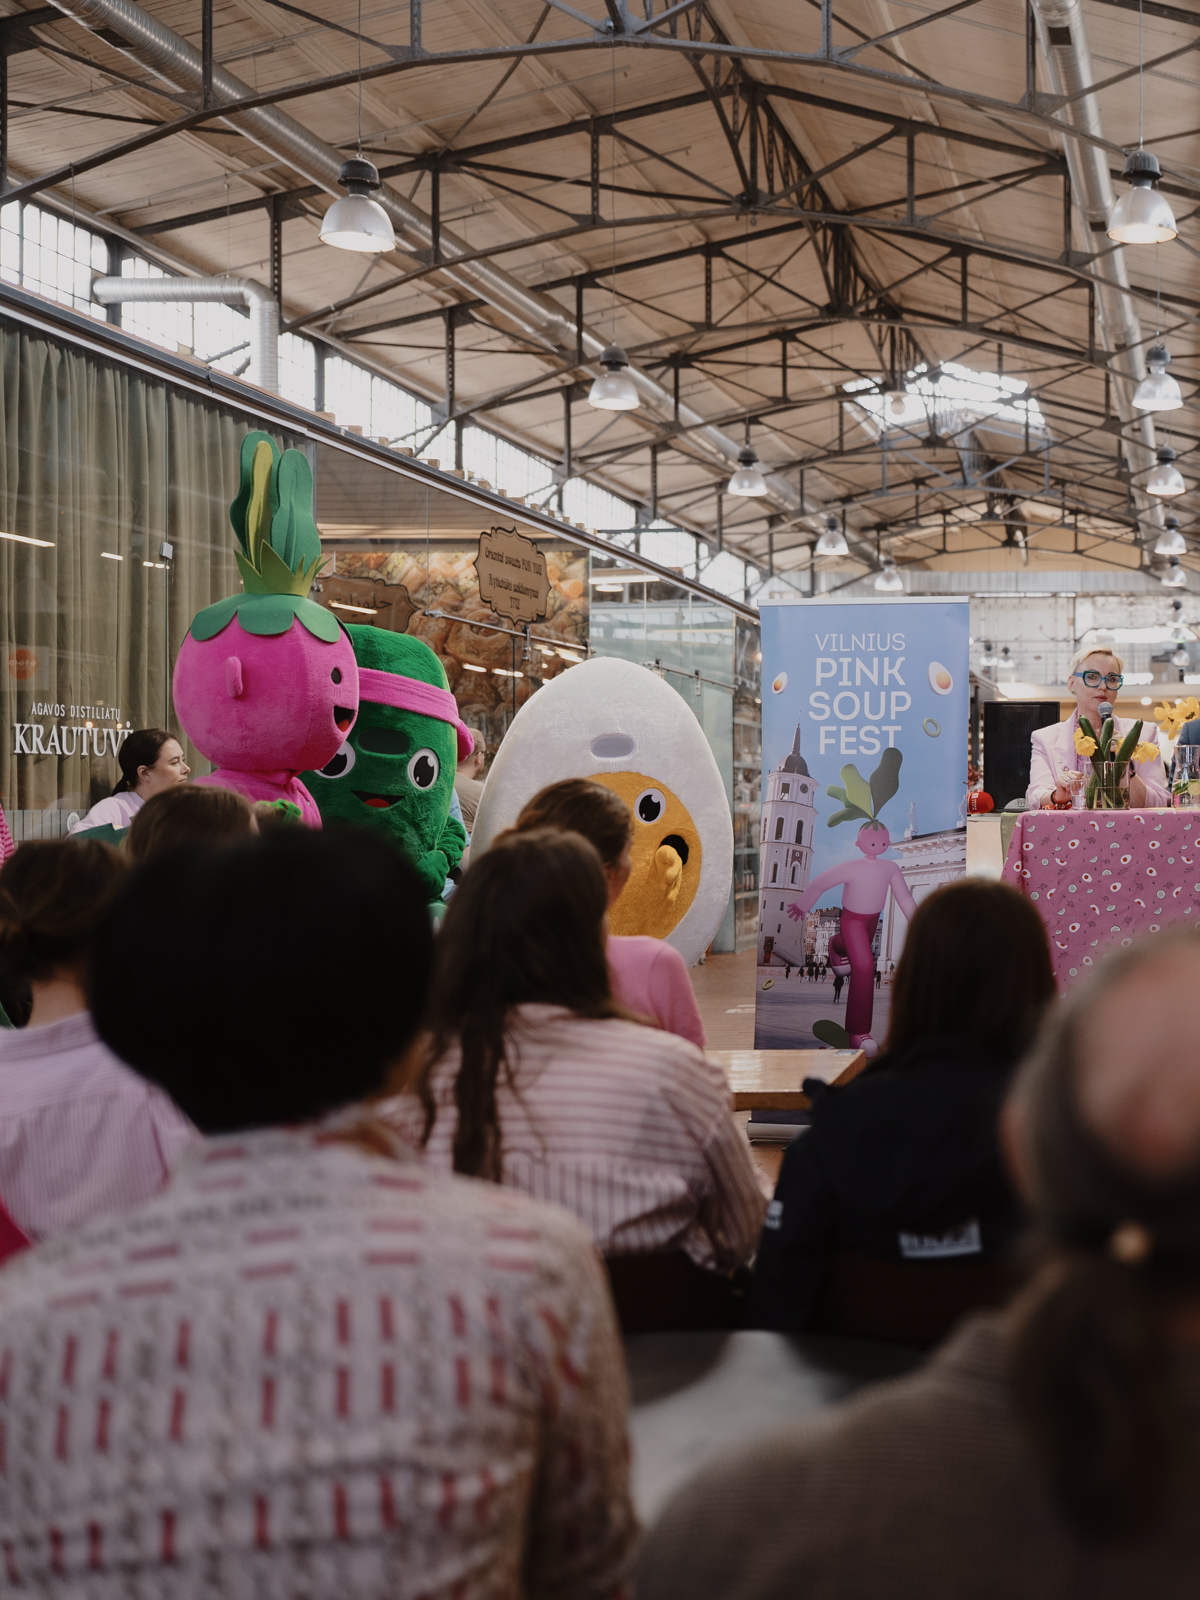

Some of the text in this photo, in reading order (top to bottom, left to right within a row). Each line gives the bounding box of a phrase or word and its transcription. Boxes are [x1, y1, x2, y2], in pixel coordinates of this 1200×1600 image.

[485, 546, 504, 563] Oriental
[522, 558, 532, 572] FOR
[533, 563, 542, 576] YOU
[815, 632, 906, 651] VILNIUS
[815, 656, 906, 686] PINK
[31, 701, 121, 722] AGAVOS DISTILIATŲ
[808, 691, 912, 721] SOUP
[820, 725, 902, 755] FEST
